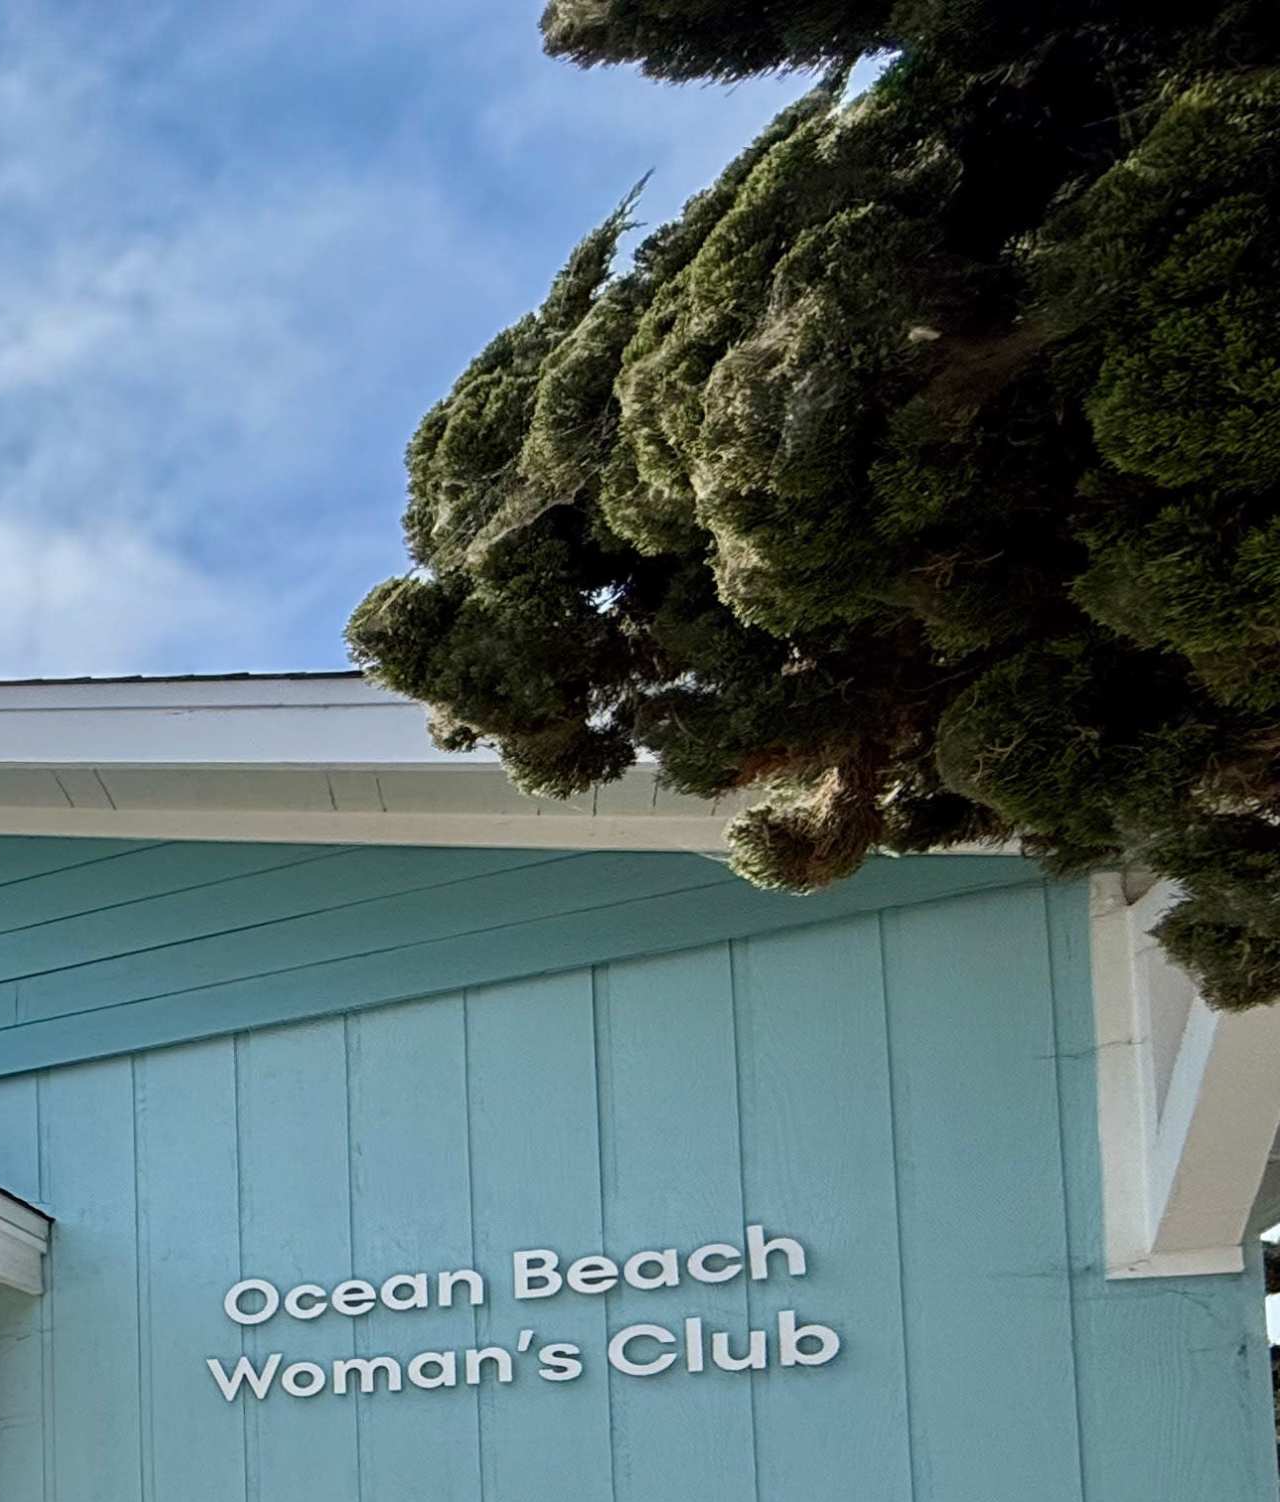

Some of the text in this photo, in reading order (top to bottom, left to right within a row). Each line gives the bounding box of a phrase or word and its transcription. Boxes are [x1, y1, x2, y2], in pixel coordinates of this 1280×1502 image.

[223, 1224, 806, 1325] Ocean Beach
[207, 1309, 839, 1402] Woman's Club
